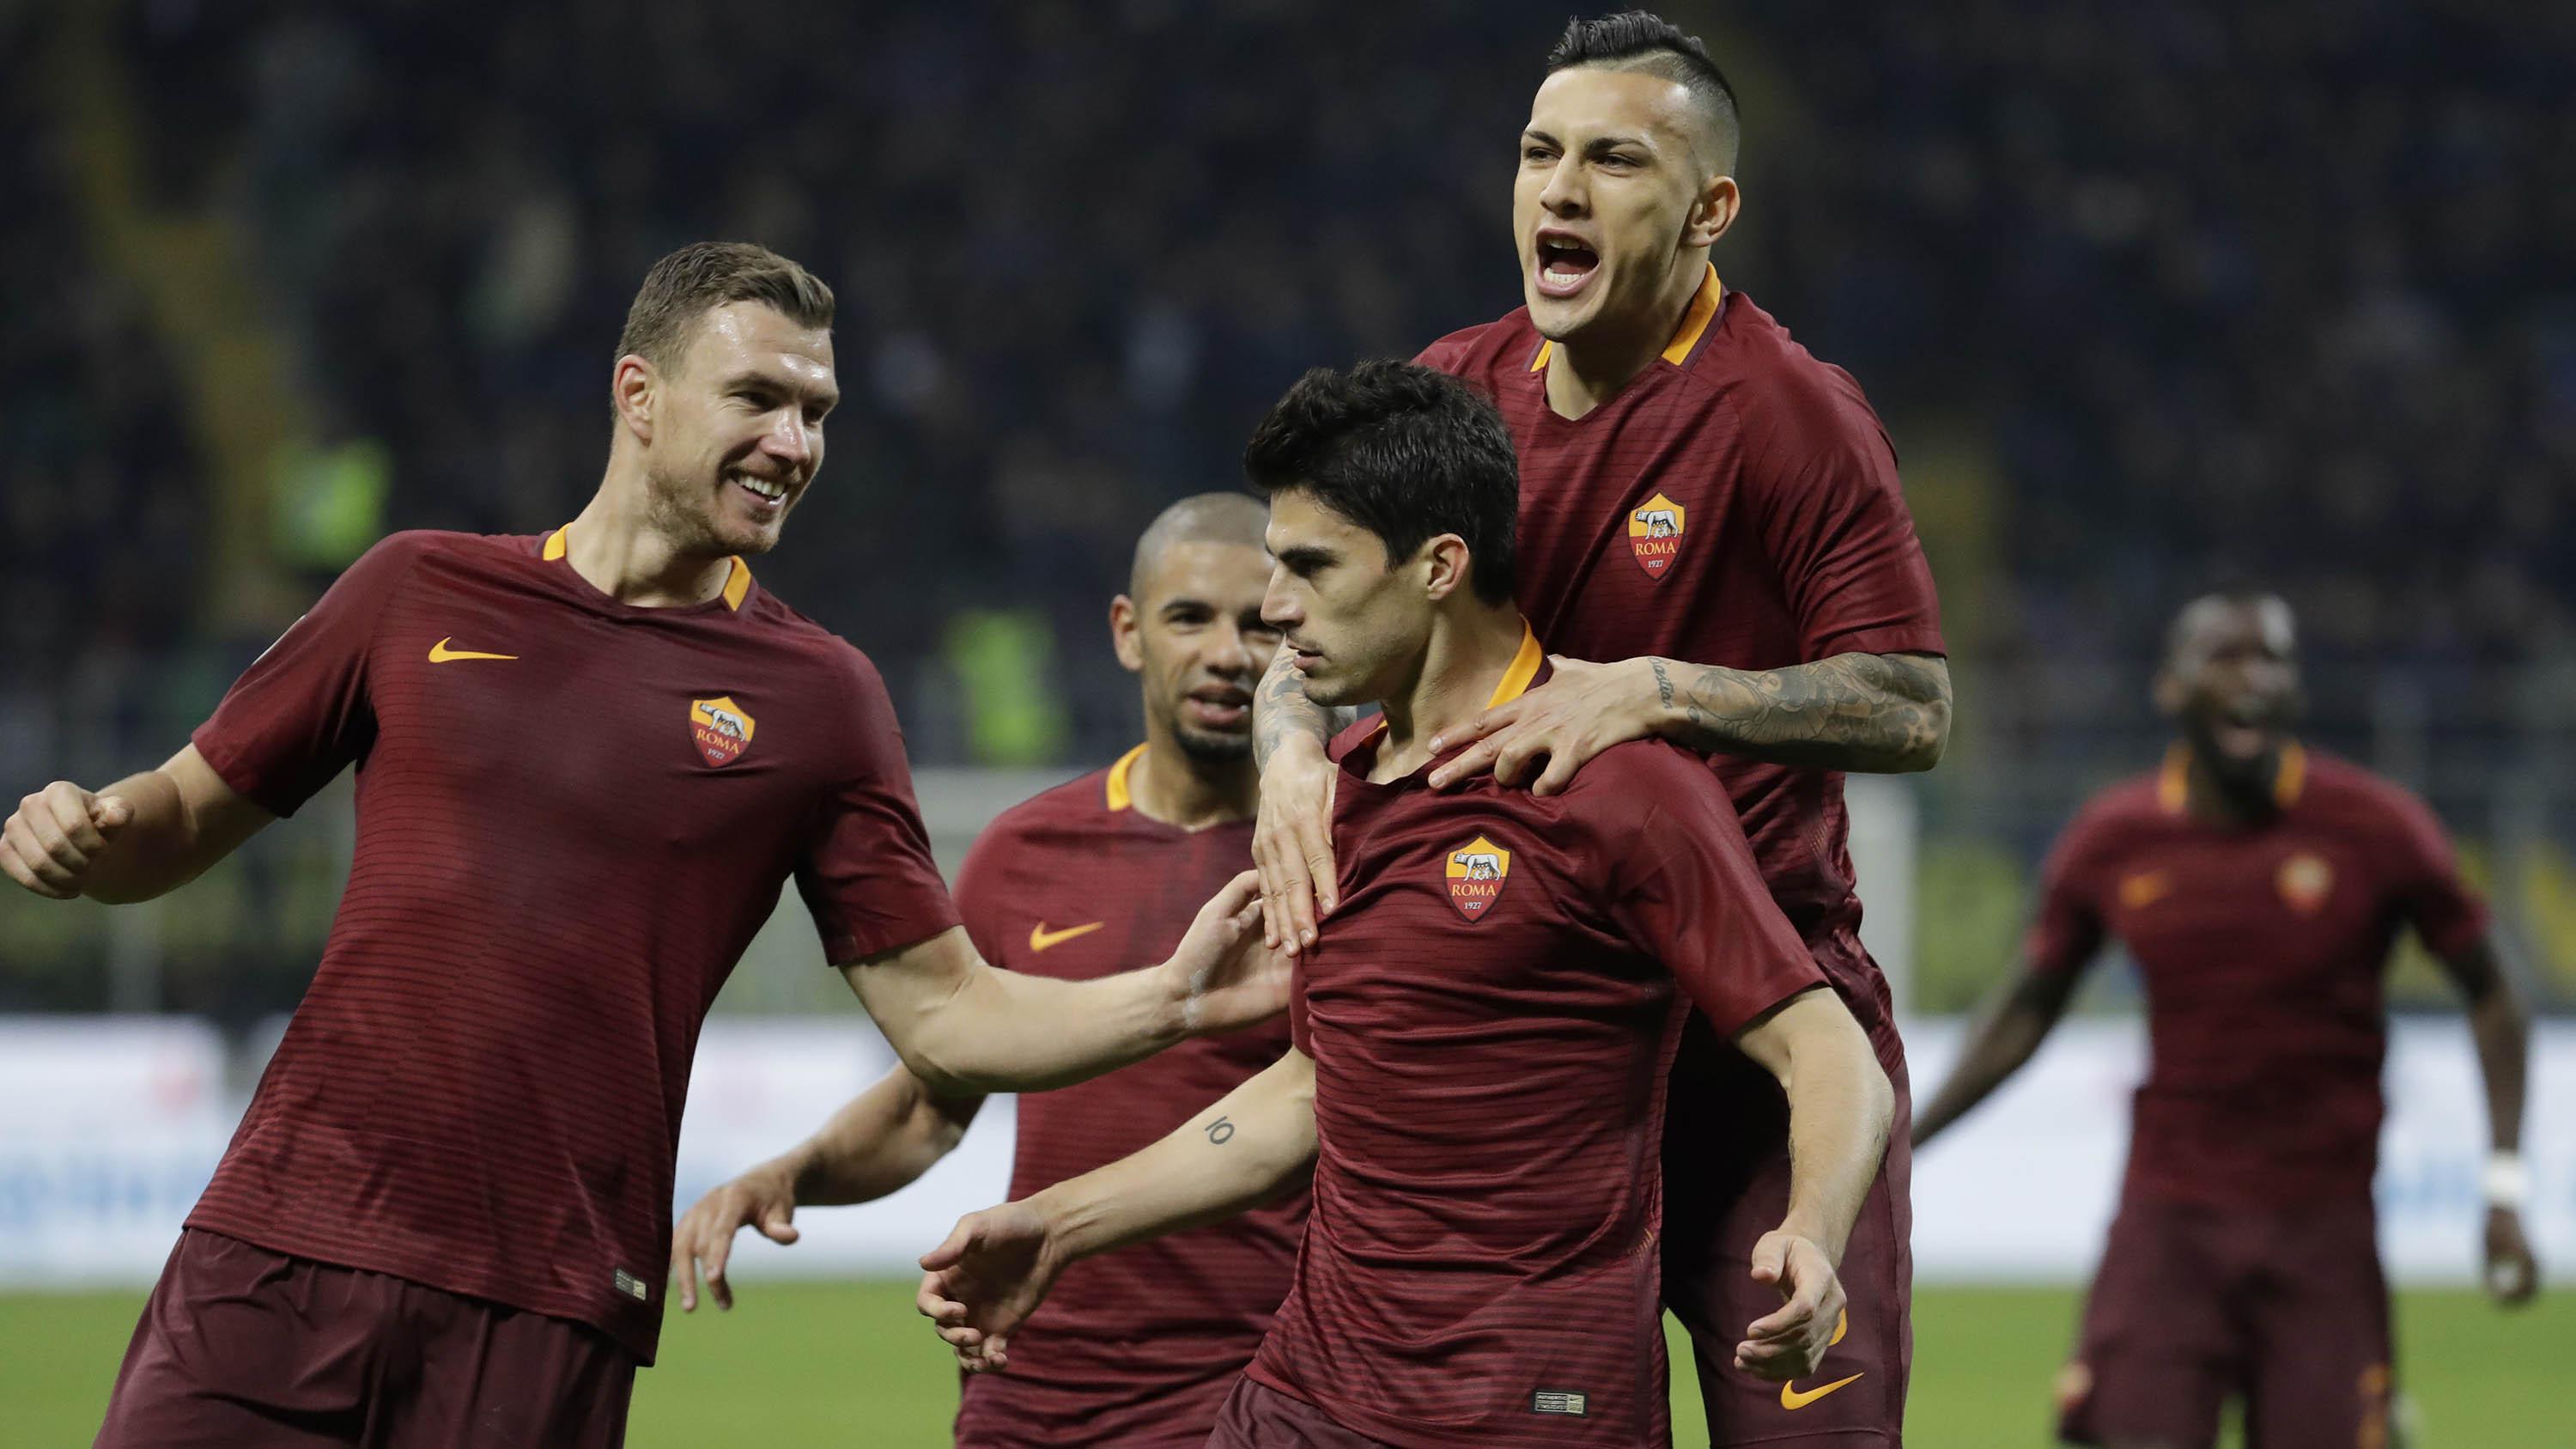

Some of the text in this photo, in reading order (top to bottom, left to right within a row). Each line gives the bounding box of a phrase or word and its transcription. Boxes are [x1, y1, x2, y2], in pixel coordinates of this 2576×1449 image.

[1635, 541, 1676, 556] ROMA
[1648, 560, 1663, 569] 1927
[696, 728, 741, 755] ROMA
[1451, 885, 1496, 897] ROMA
[1204, 1116, 1235, 1145] 10
